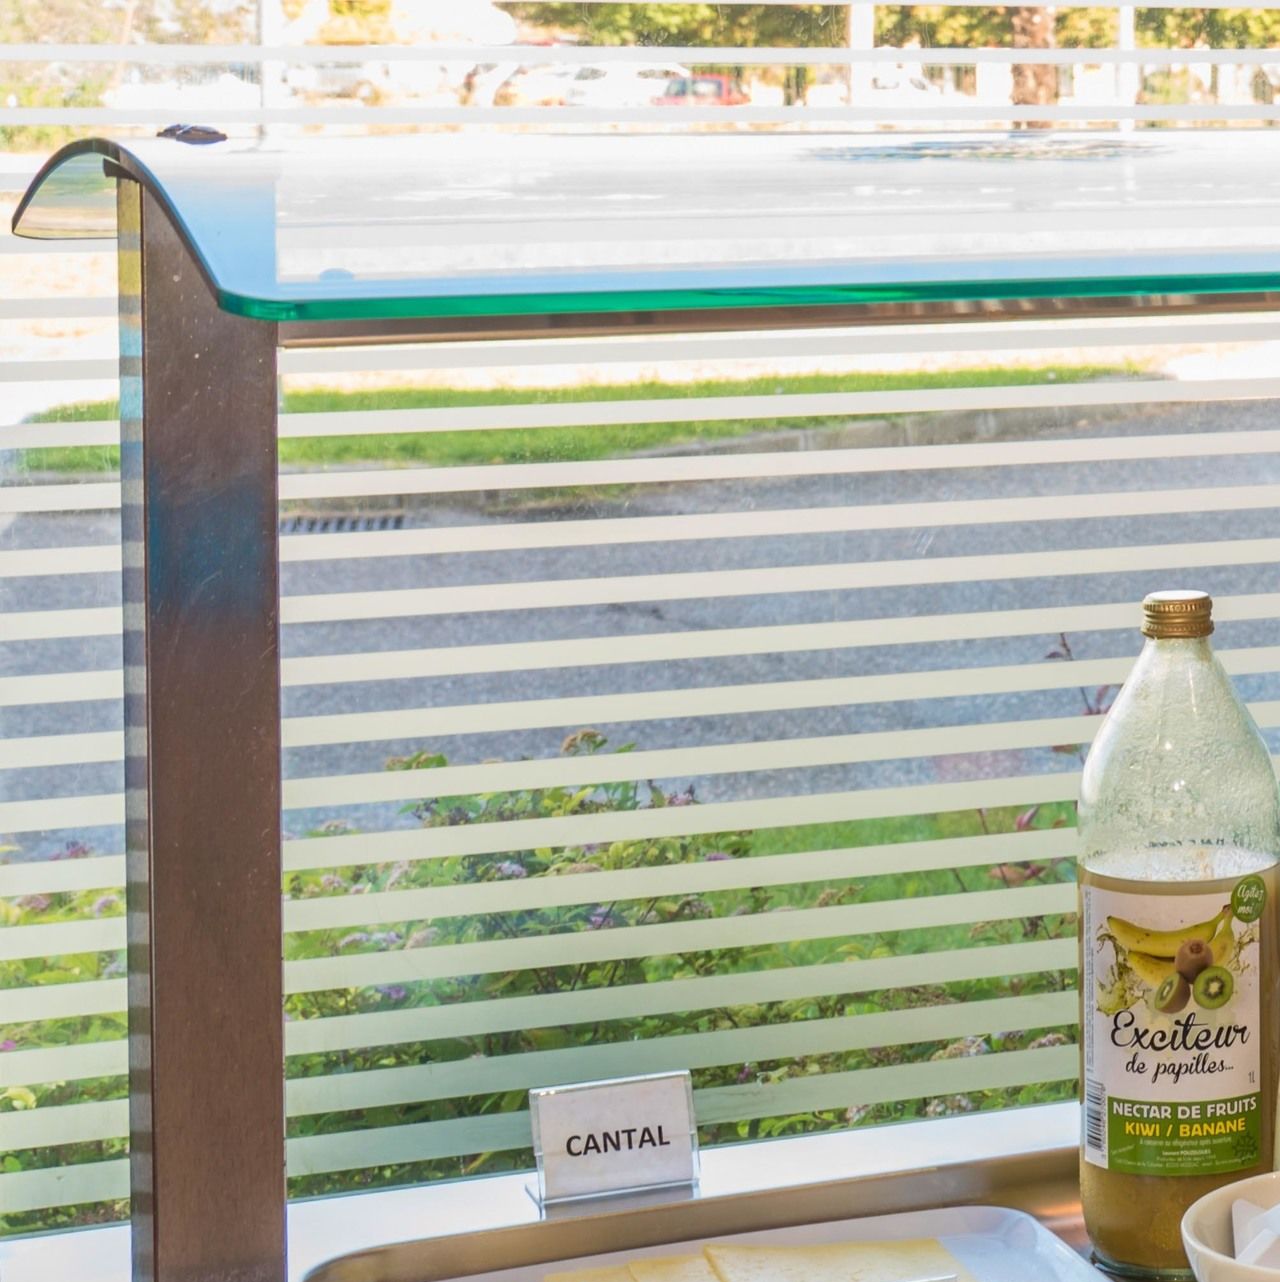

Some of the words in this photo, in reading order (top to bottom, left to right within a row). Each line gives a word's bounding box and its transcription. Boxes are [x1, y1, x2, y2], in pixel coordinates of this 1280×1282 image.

[1110, 1009, 1250, 1051] Exciteur
[1125, 1052, 1149, 1074] de
[1151, 1052, 1234, 1084] papilles...
[1113, 1101, 1172, 1119] NECTAR
[1177, 1105, 1202, 1120] DE
[1206, 1096, 1257, 1117] FRUITS
[566, 1125, 671, 1157] CANTAL
[1124, 1120, 1161, 1137] KIWI
[1165, 1124, 1174, 1138] /
[1178, 1117, 1246, 1138] BANANE
